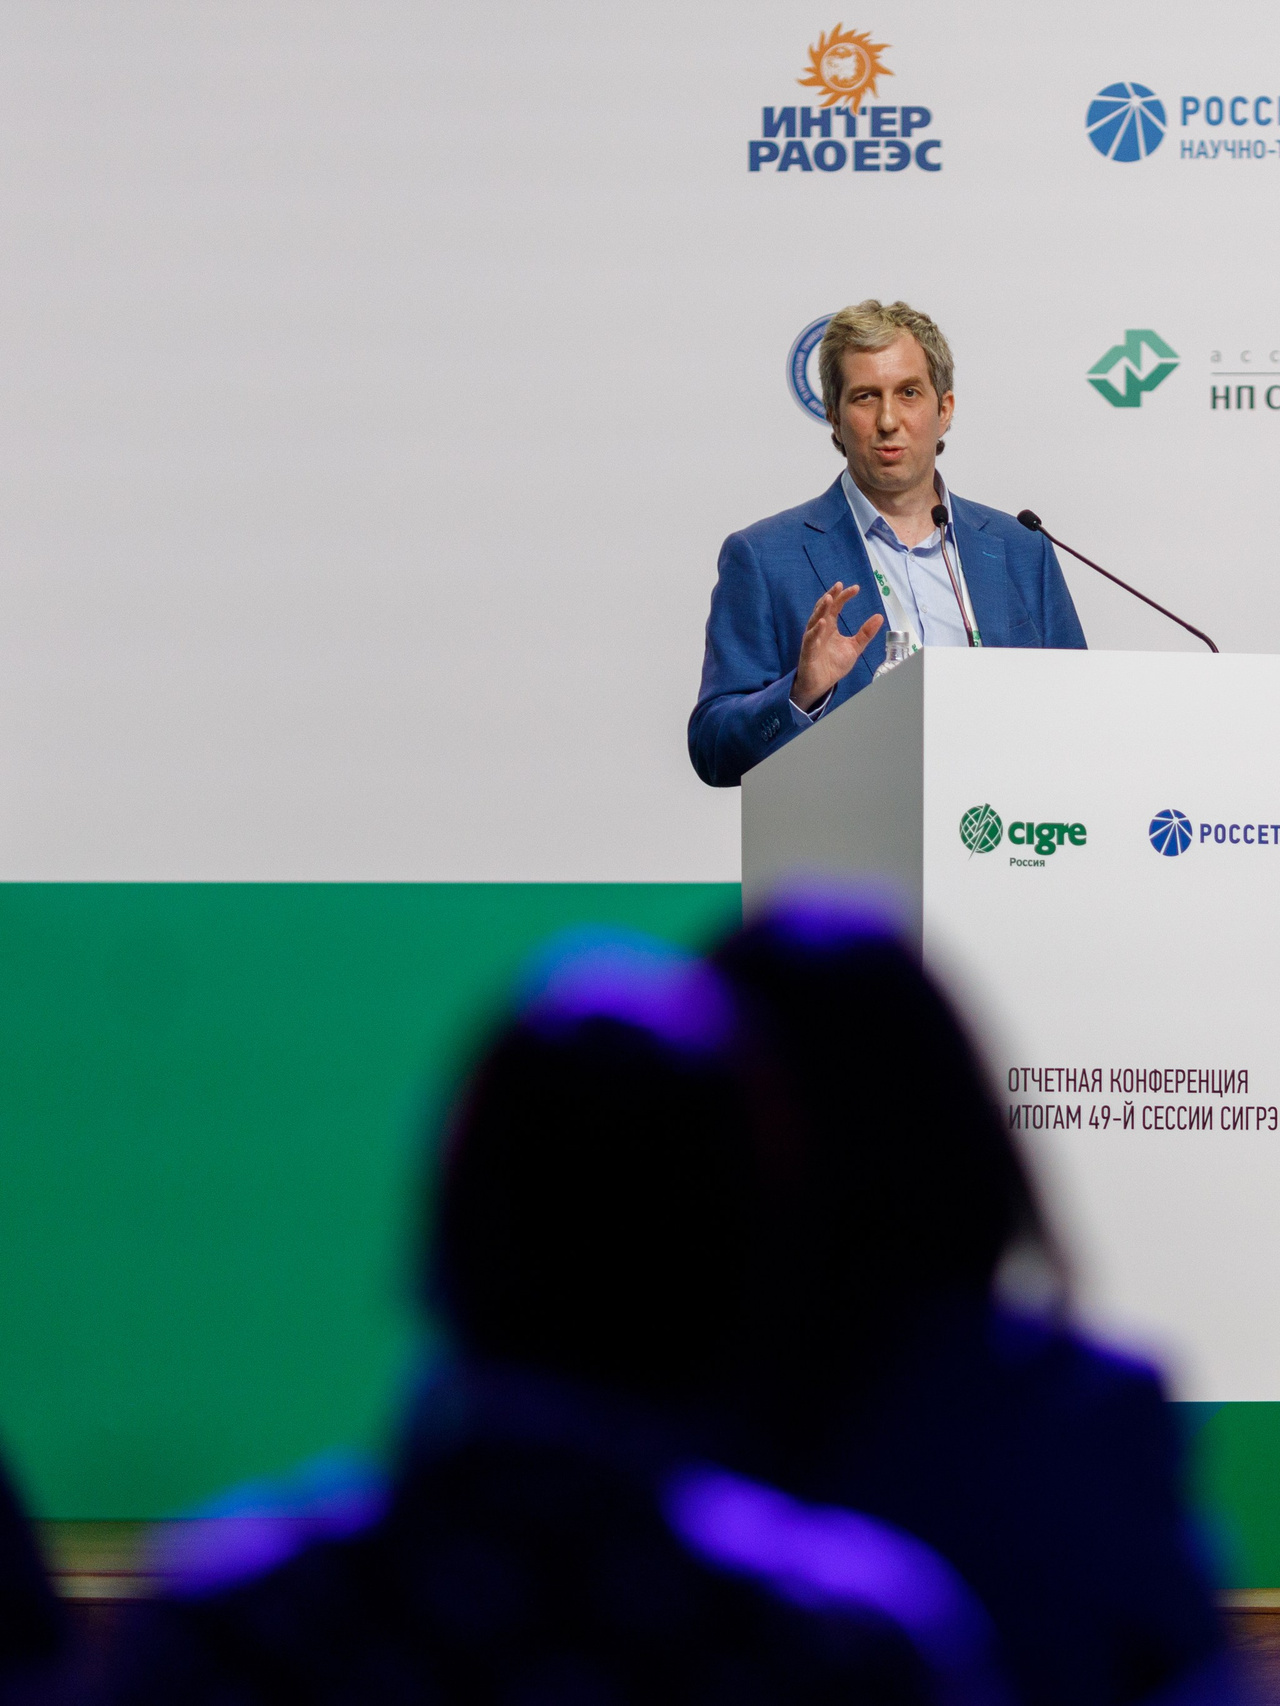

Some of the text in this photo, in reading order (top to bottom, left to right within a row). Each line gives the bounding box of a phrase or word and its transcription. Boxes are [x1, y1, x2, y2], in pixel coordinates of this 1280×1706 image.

[763, 105, 933, 138] ИНТЕР
[1211, 385, 1256, 410] НП
[1008, 821, 1088, 856] cigre
[1009, 857, 1047, 868] Россия
[1008, 1067, 1250, 1098] ОТЧЕТНАЯ КОНФЕРЕНЦИЯ
[1008, 1100, 1279, 1131] ИТОГАМ 49-Й СЕССИИ СИГРЭ
